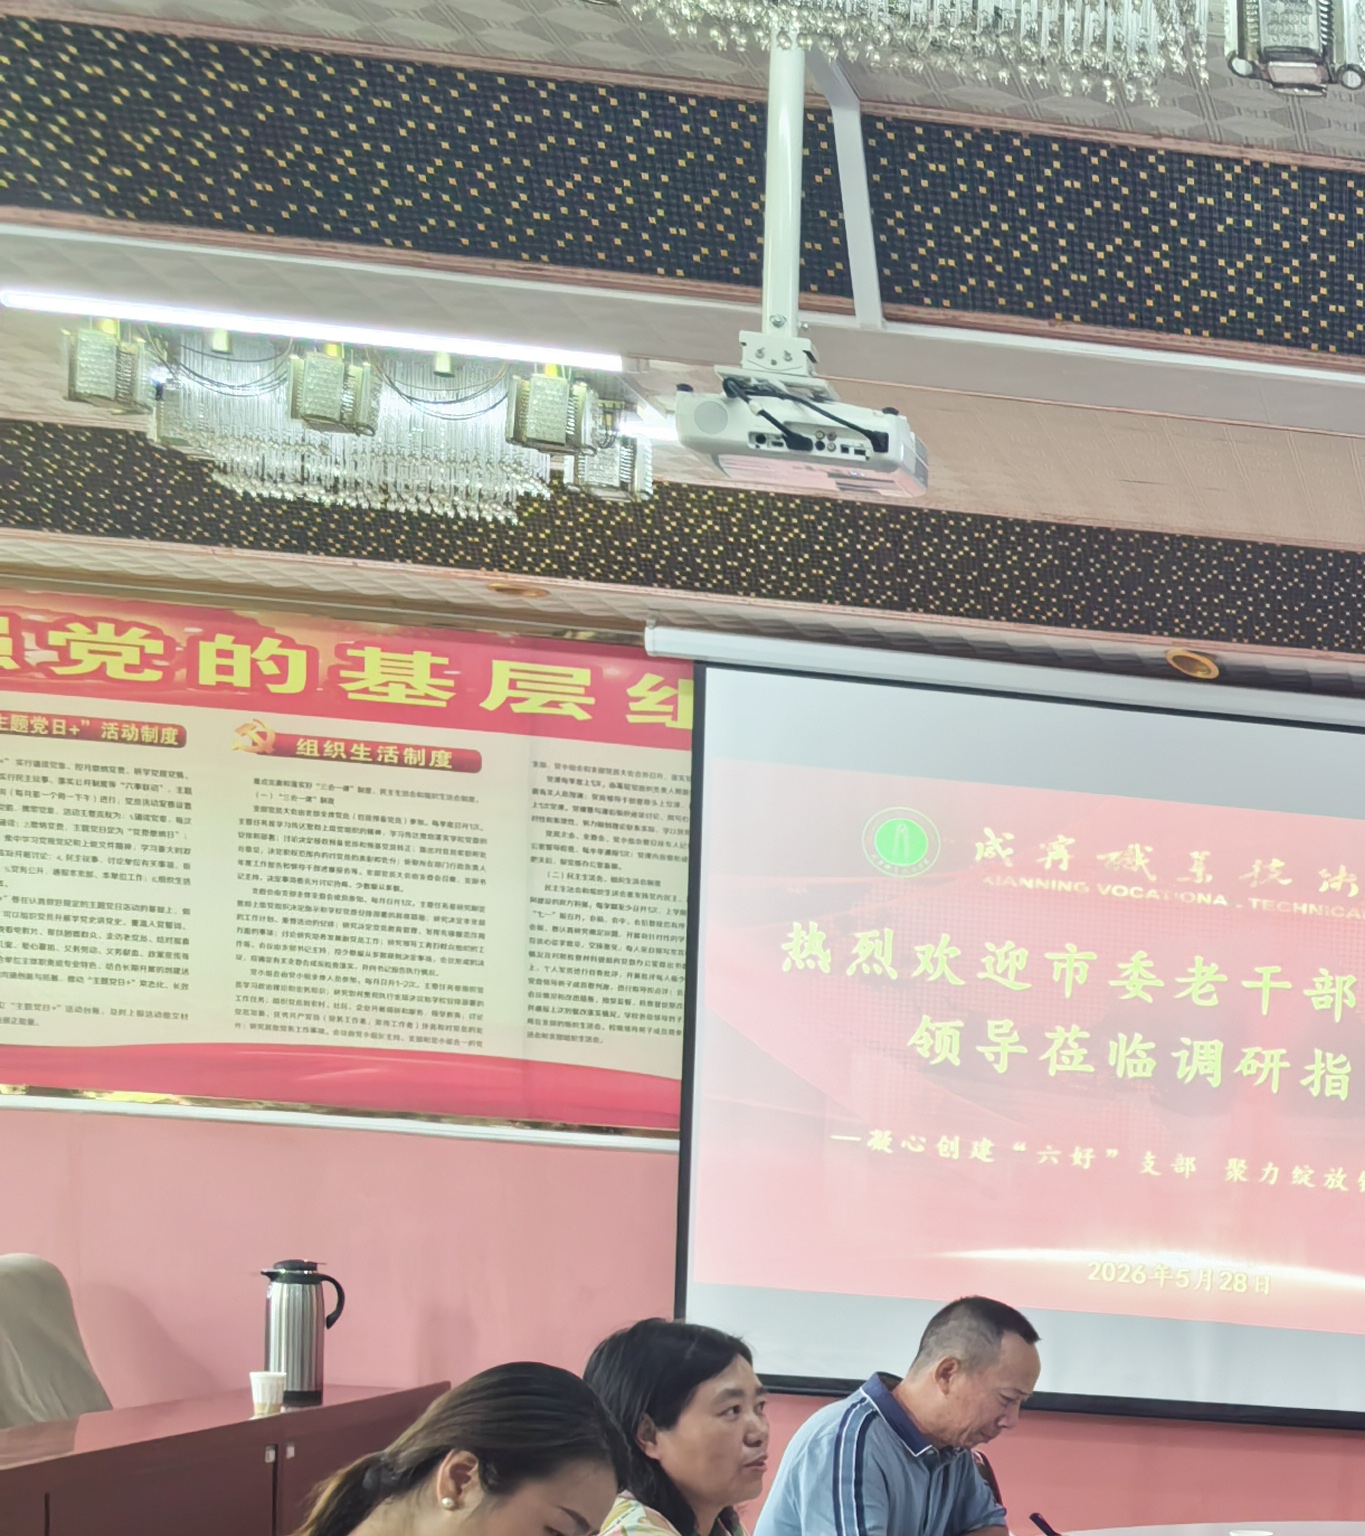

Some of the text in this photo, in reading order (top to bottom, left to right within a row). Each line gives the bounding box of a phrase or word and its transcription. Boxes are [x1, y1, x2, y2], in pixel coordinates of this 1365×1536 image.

[0, 616, 693, 730] 党的基层组
[296, 738, 452, 770] 组织生活制度
[1087, 1261, 1272, 1295] 2026年5月28日
